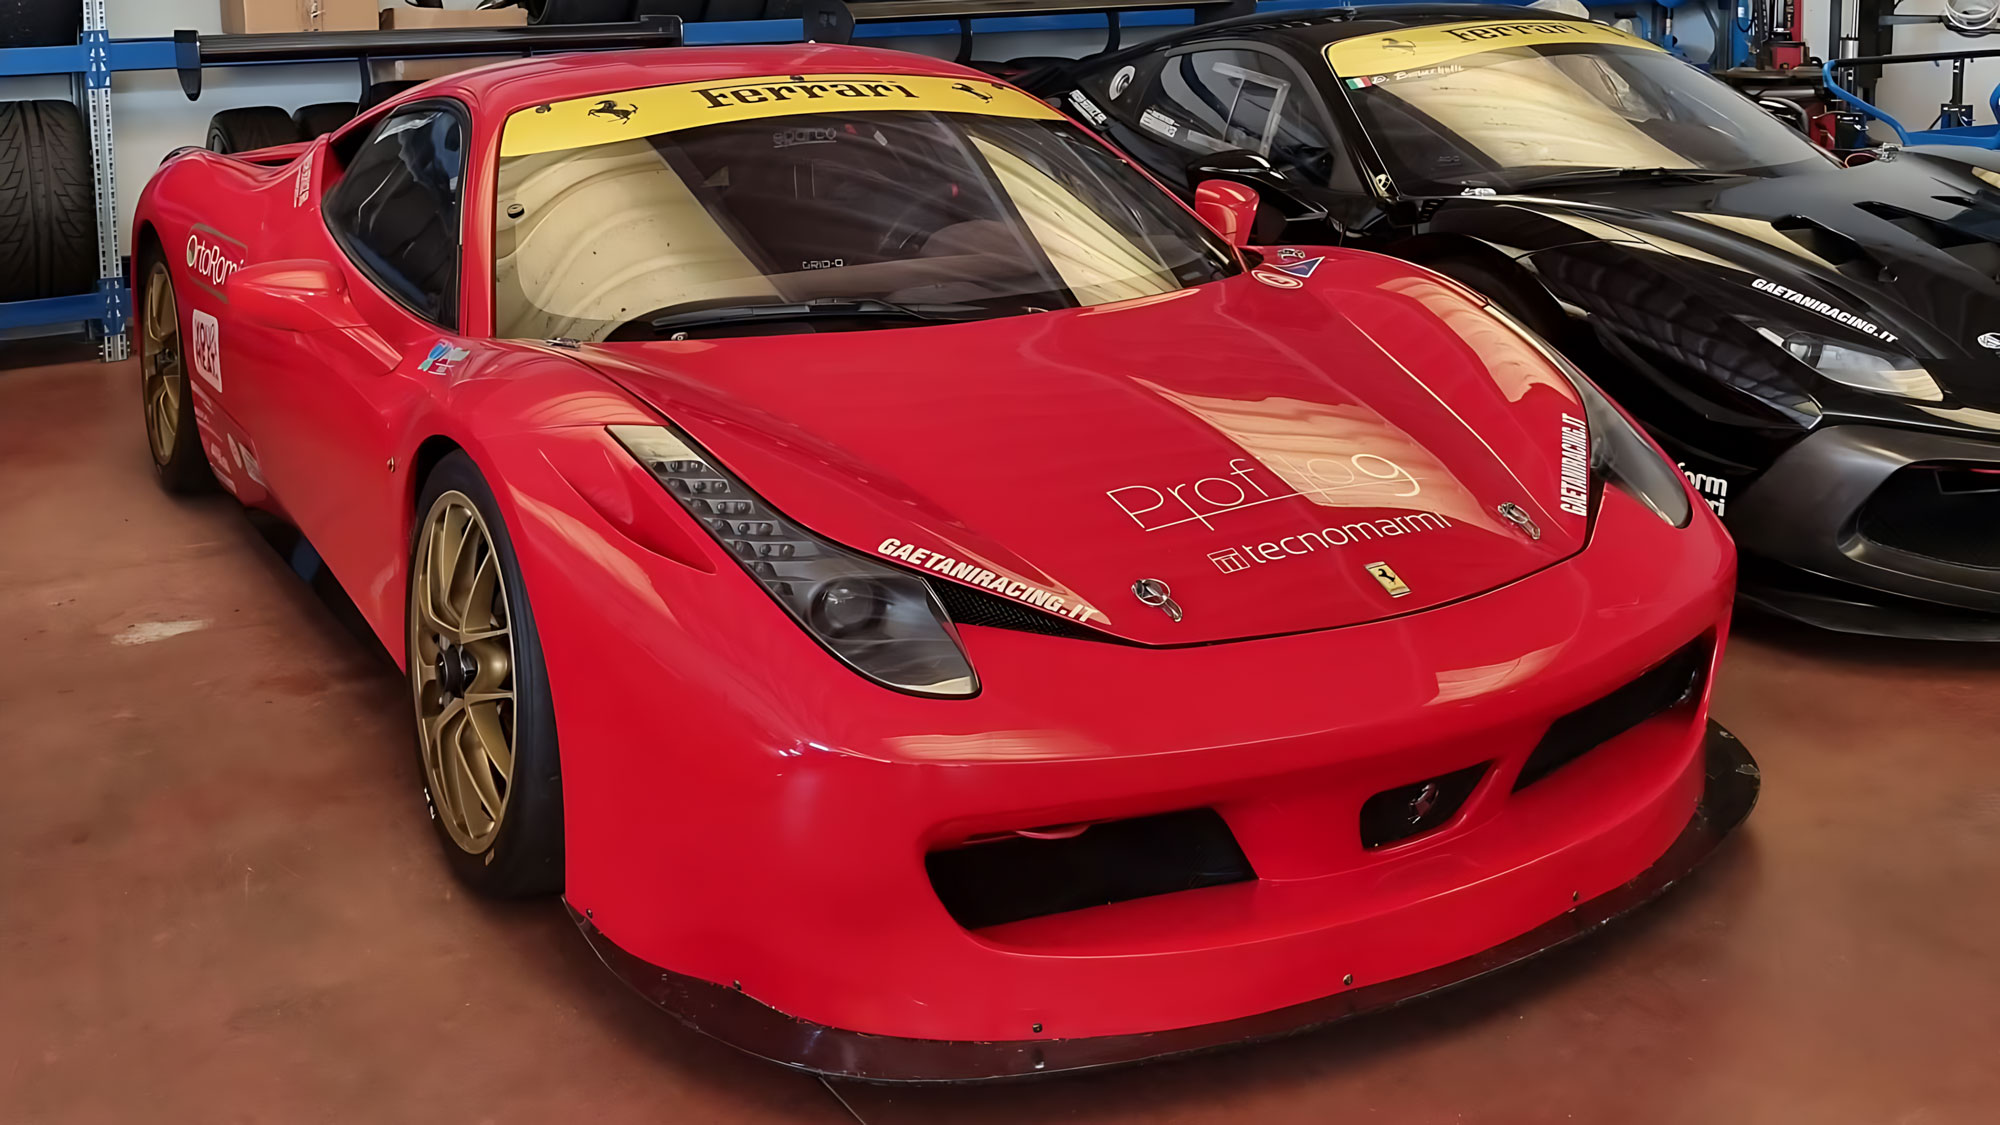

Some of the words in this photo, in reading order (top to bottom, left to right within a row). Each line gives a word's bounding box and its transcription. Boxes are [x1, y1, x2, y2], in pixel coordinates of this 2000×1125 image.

[1440, 22, 1588, 43] Ferrari
[691, 80, 920, 108] Ferrari
[1751, 278, 1899, 343] GAETANIRACING.IT
[1560, 412, 1588, 517] GAETANIRACING.IT
[877, 537, 1100, 623] GAETANIRACING.IT
